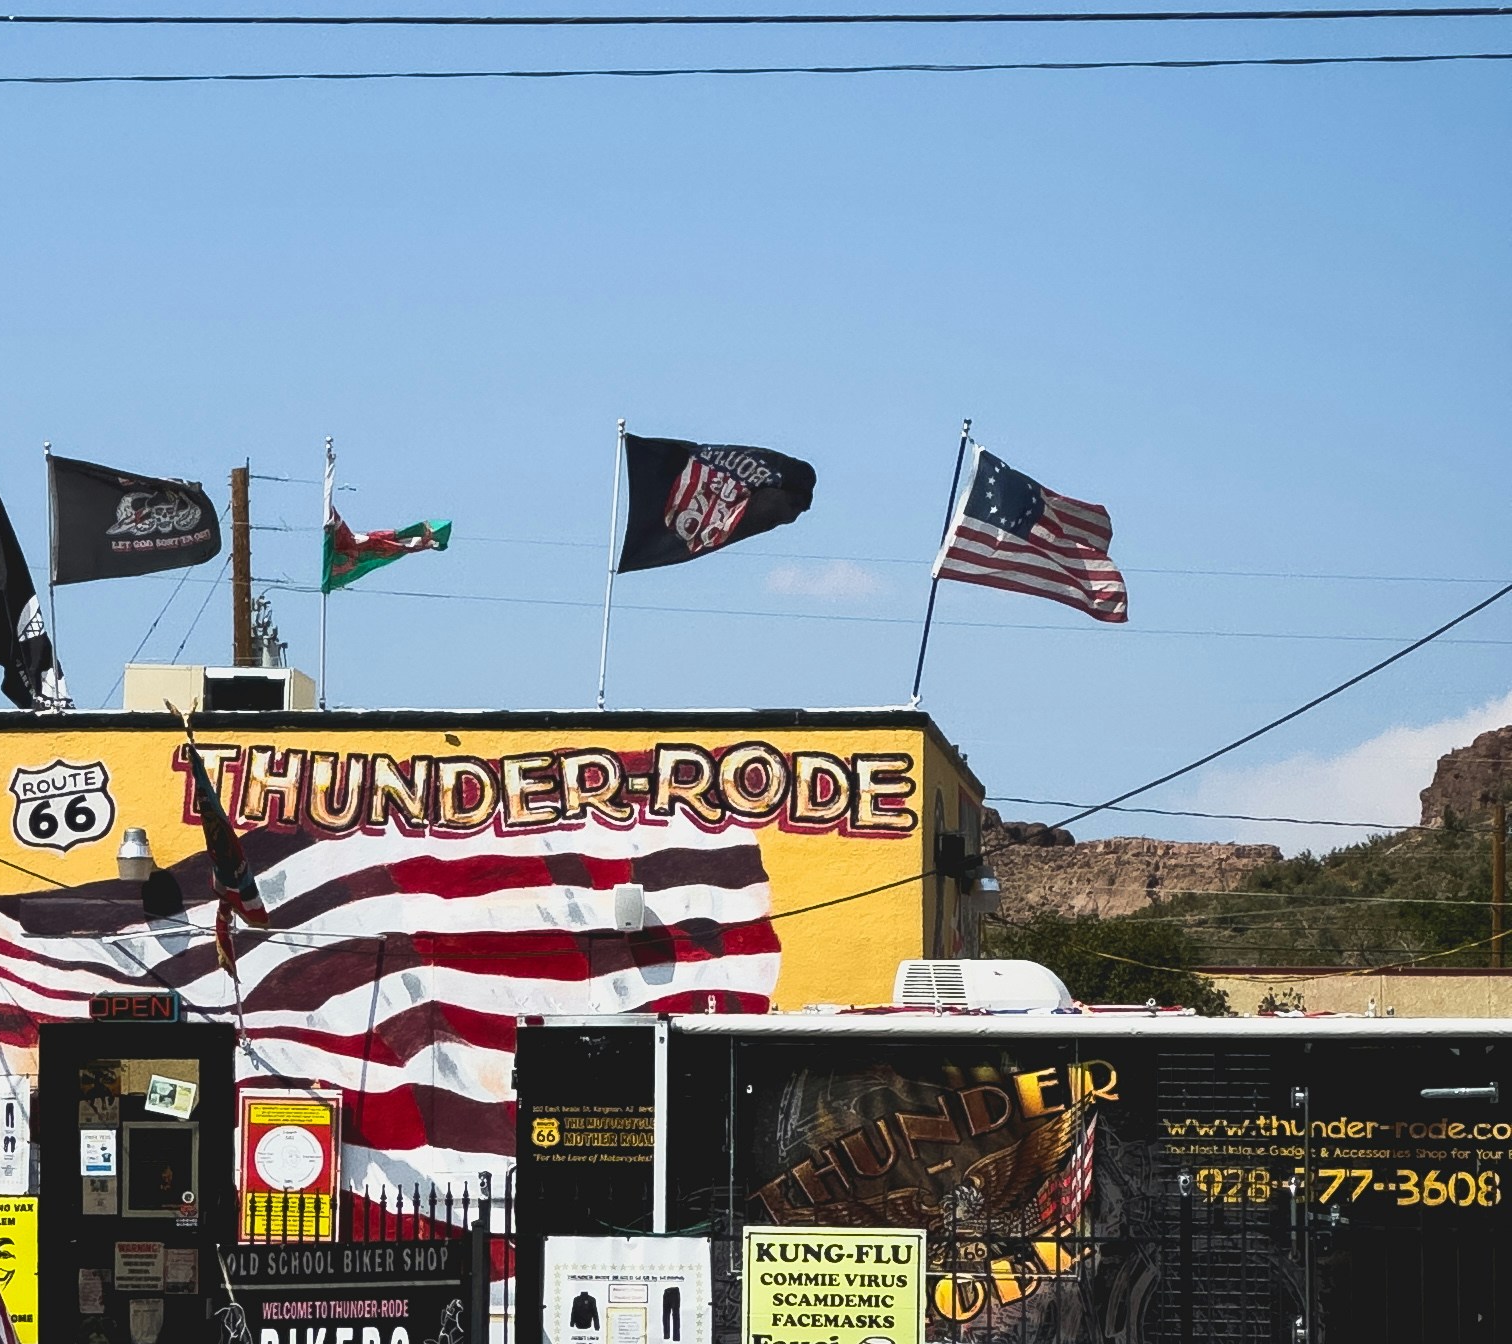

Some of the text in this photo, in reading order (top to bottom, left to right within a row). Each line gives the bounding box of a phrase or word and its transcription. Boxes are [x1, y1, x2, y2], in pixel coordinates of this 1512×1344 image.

[23, 771, 95, 796] ROUTE
[178, 741, 920, 836] THUNDER-RODE
[29, 794, 96, 839] 66
[89, 997, 171, 1017] OPEN
[536, 1129, 556, 1143] 66
[1164, 1115, 1512, 1140] www.thunder-rode.co
[564, 1132, 618, 1147] MOTHER
[748, 1058, 1120, 1225] THUNDER
[1416, 1148, 1447, 1160] Shop
[1451, 1147, 1471, 1159] for
[1475, 1148, 1504, 1159] Your
[14, 1204, 34, 1212] VAX
[228, 1247, 448, 1276] OLD SCHOOL BIKER SHOP
[756, 1243, 913, 1264] KUNG-FLU
[760, 1273, 908, 1288] COMMIE VIRUS
[262, 1299, 409, 1320] WELCOME TO THUNDER-RODE
[772, 1293, 894, 1309] SCAMDEMIC
[772, 1313, 895, 1329] FACEMASKS
